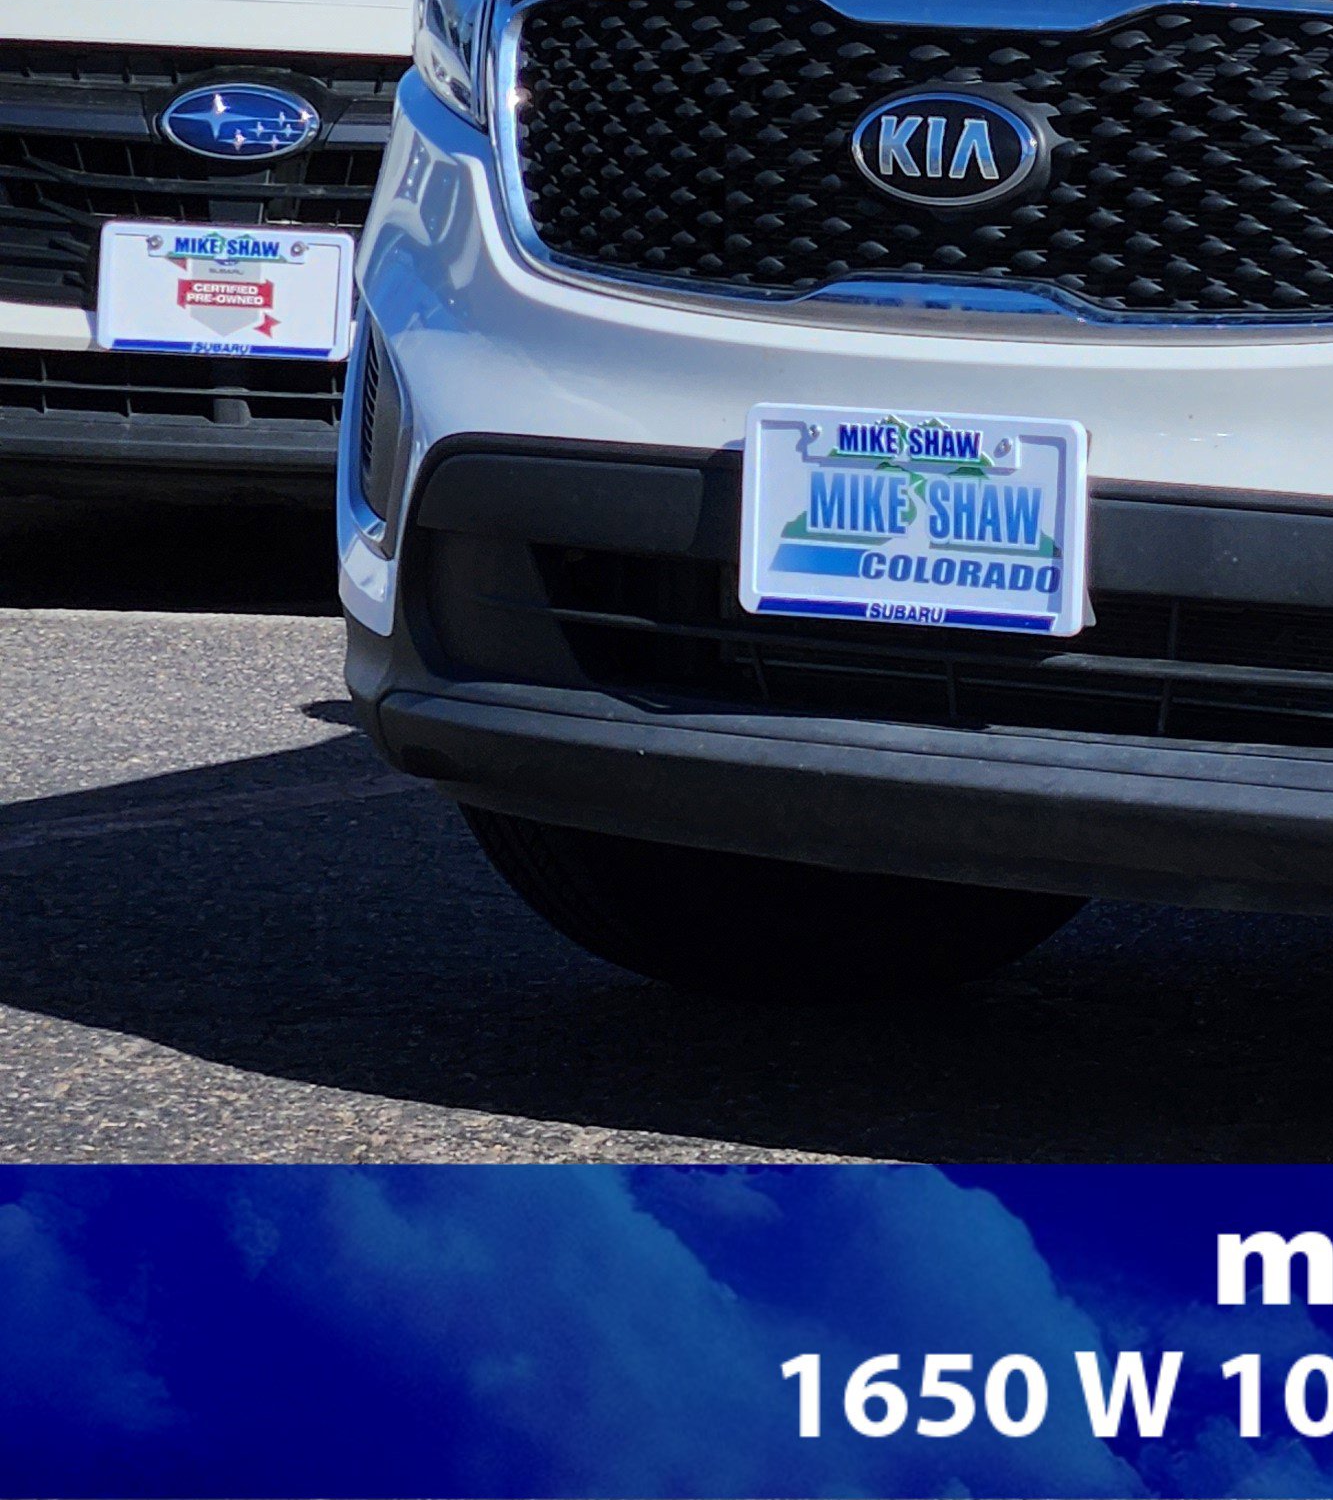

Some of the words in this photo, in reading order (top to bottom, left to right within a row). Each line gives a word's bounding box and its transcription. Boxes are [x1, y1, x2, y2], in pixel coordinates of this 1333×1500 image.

[878, 115, 1000, 180] KIA
[175, 236, 219, 254] MIKE
[227, 239, 280, 257] SHAW
[208, 267, 245, 276] SUBARU
[186, 293, 264, 305] PRE-OWNED
[193, 283, 258, 295] CERTIFIED
[194, 341, 248, 355] SUBARU
[838, 423, 898, 455] MIKE
[908, 424, 982, 459] SHAW
[810, 470, 908, 536] MIKE
[928, 478, 1043, 546] SHAW
[861, 552, 1063, 594] COLORADO
[869, 603, 944, 623] SUBARU
